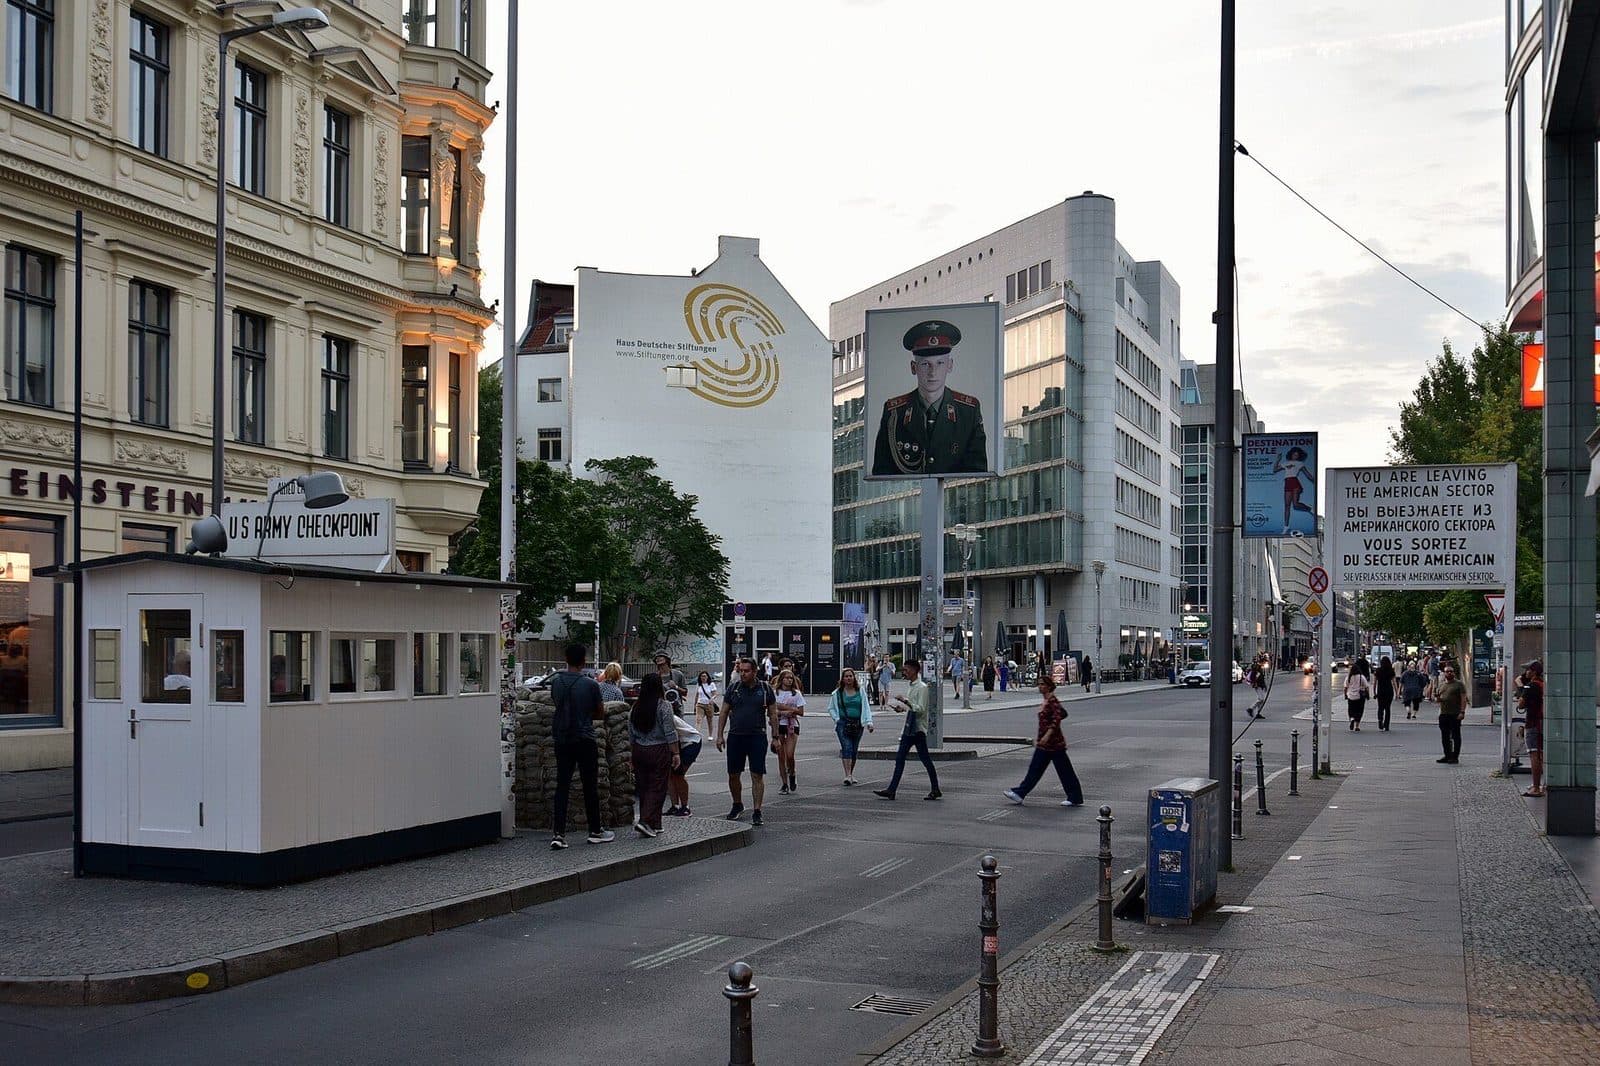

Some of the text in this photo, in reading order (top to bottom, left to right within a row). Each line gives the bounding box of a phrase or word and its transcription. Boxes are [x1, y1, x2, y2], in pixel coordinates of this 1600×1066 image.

[616, 339, 717, 353] Haus Deutscher Stiftungen
[616, 350, 690, 362] www.Stiftungen.org
[1247, 438, 1313, 447] DESTINATION
[1247, 447, 1277, 455] STYLE
[1353, 468, 1487, 483] YOU ARE LEAVING
[10, 468, 204, 516] EINSTEIN
[1345, 484, 1495, 499] THE AMERICAN SECTOR
[1347, 503, 1492, 518] ВЫ ВЫЕЗЖАЕТЕ ИЗ
[229, 512, 380, 540] U S ARMY CHECKPOINT
[1343, 519, 1496, 533] АМЕРИКАНСКОГО СЕКТОРА
[1363, 537, 1467, 551] VOUS SORTEZ
[1343, 551, 1495, 566] DU SECTEUR AMÉRICAIN
[1343, 571, 1495, 582] SIE VERLASSEN DEN AMERIKANISCHEN SEKTOR
